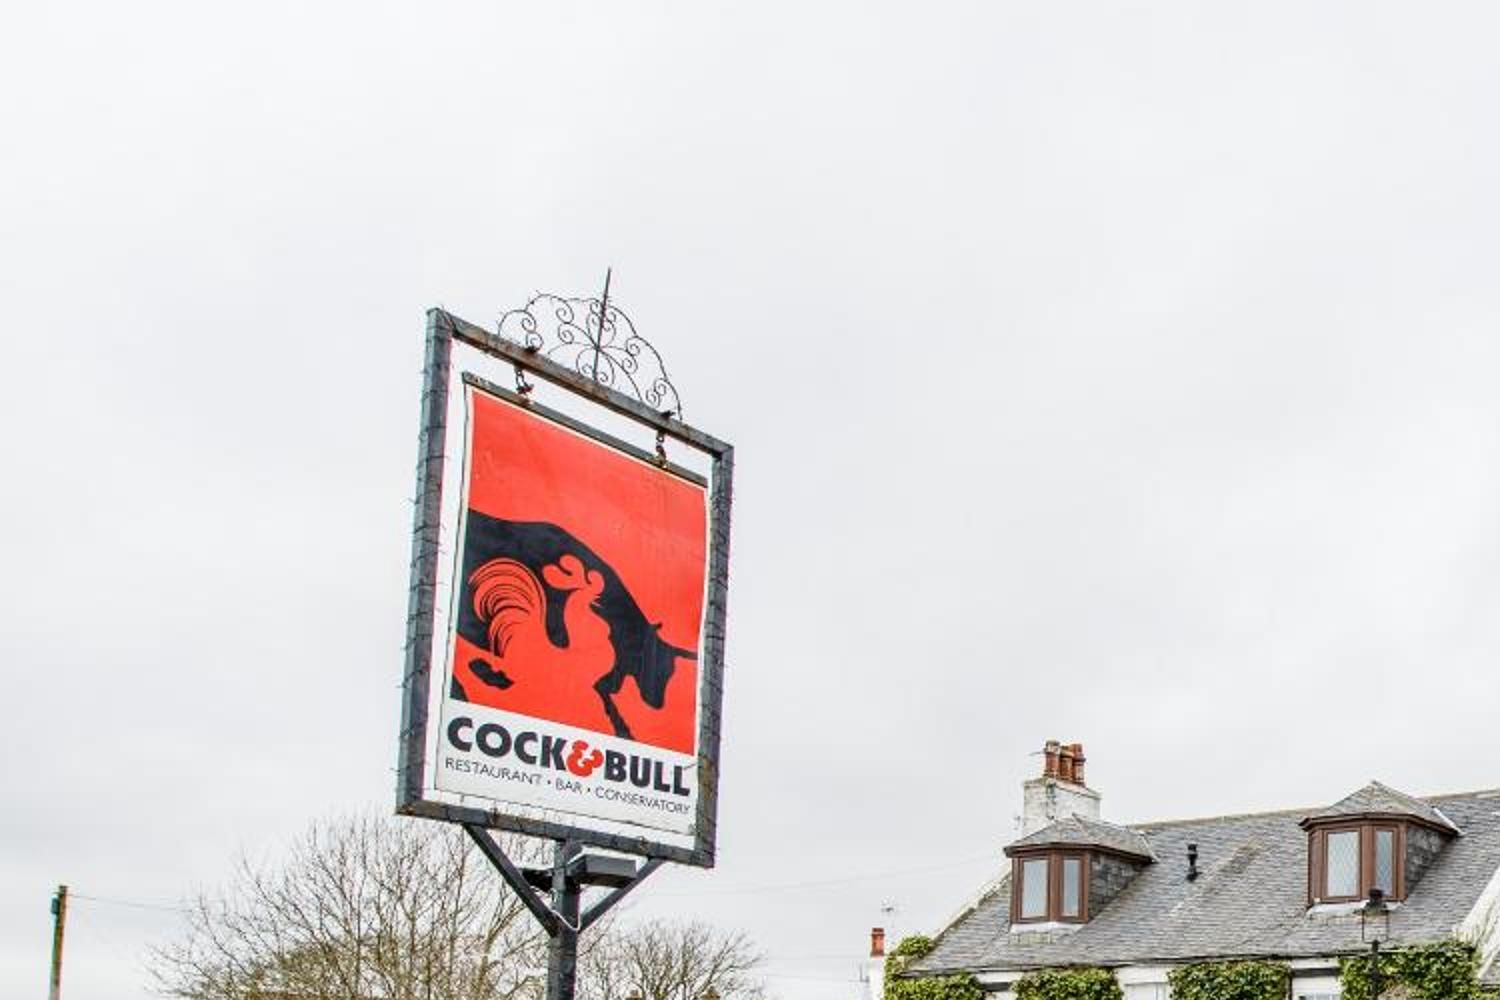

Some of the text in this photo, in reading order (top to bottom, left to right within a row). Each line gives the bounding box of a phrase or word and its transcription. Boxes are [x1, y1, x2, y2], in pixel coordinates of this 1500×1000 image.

[445, 758, 691, 814] RESTAURANT BAR CONSERVATORY
[447, 717, 690, 796] COCK&BULL
